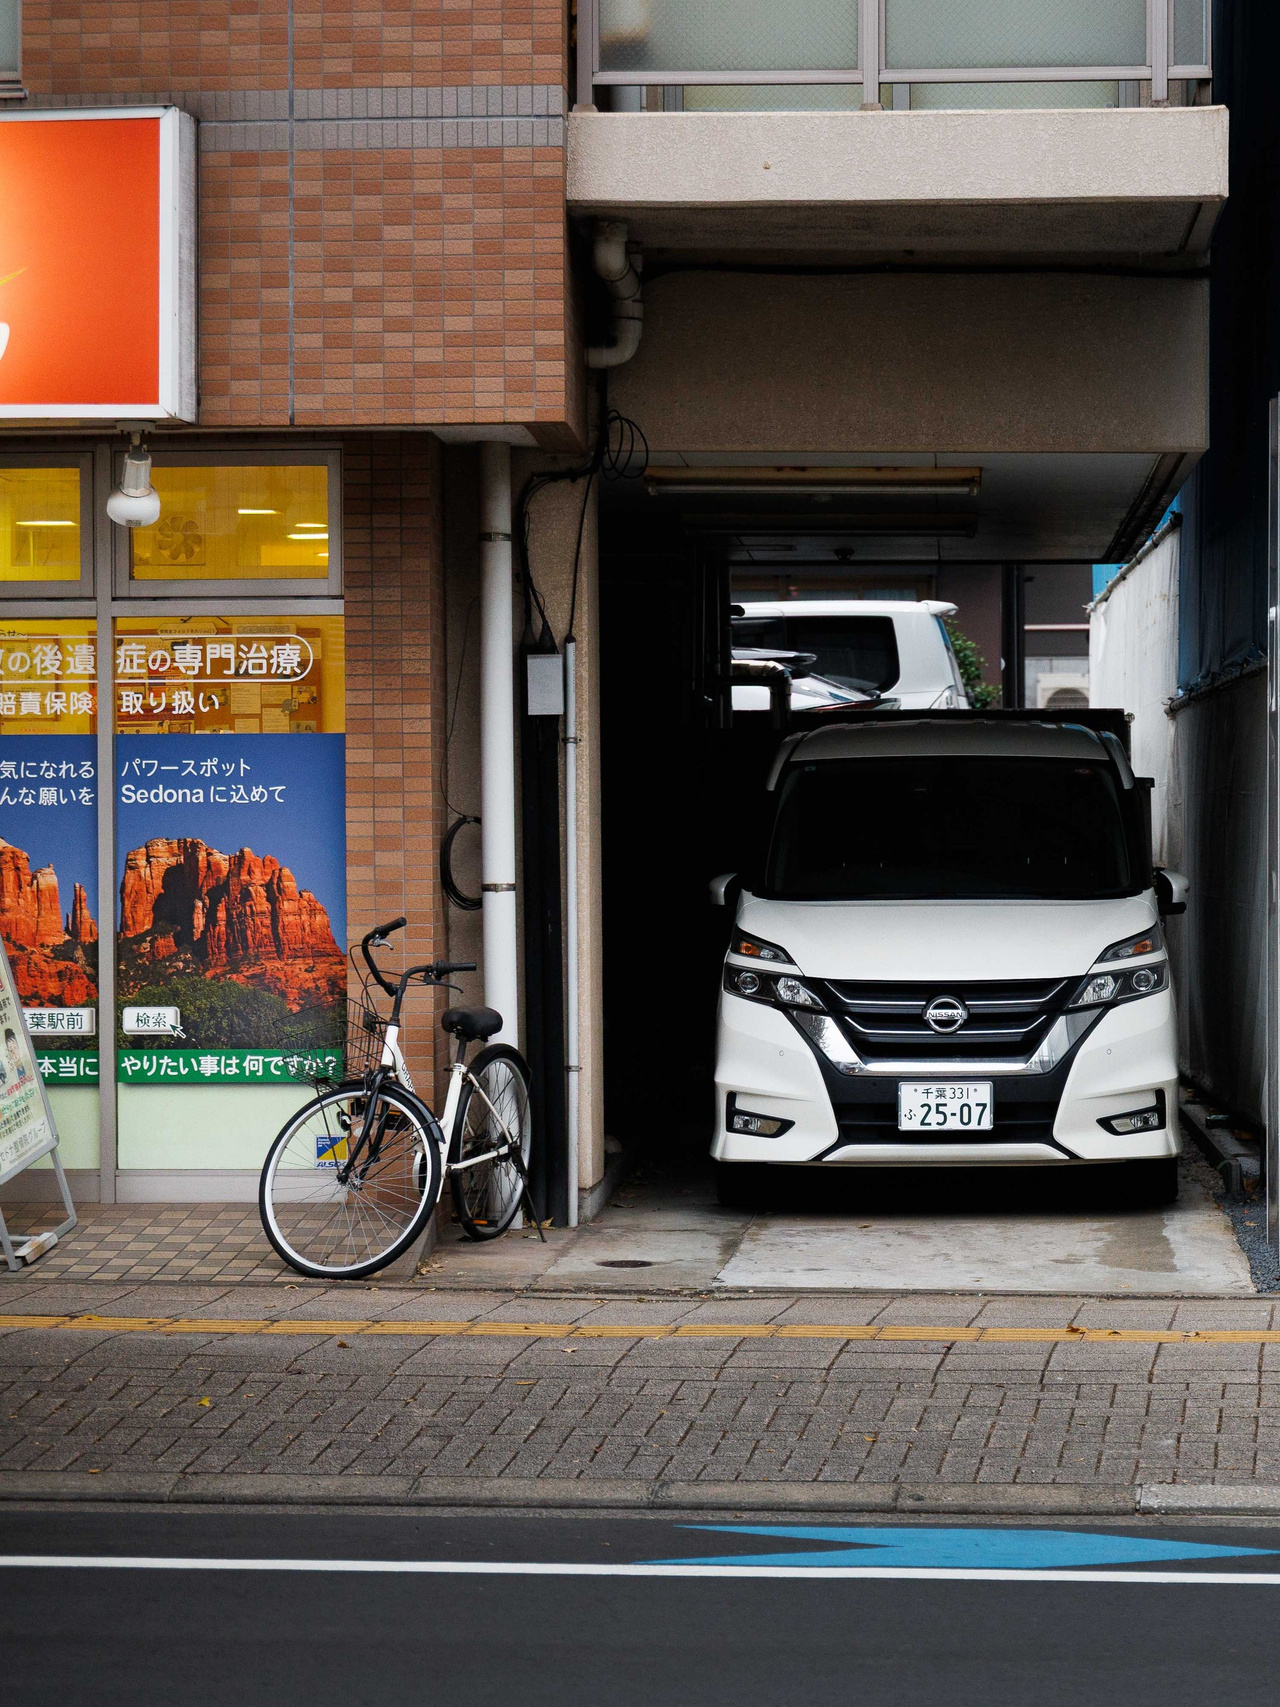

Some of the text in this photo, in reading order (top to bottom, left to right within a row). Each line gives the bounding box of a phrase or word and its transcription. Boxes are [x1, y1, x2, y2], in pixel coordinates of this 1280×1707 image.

[0, 643, 301, 675] の後遺 症の専門治療
[121, 691, 219, 715] 取り扱い
[0, 758, 251, 779] 気になれる パワースポット
[0, 787, 95, 806] んな願いを
[23, 1013, 84, 1030] 葉駅前
[135, 1013, 167, 1028] 検索
[37, 1056, 98, 1077] 本当に
[904, 1103, 987, 1126] ふ 25-07
